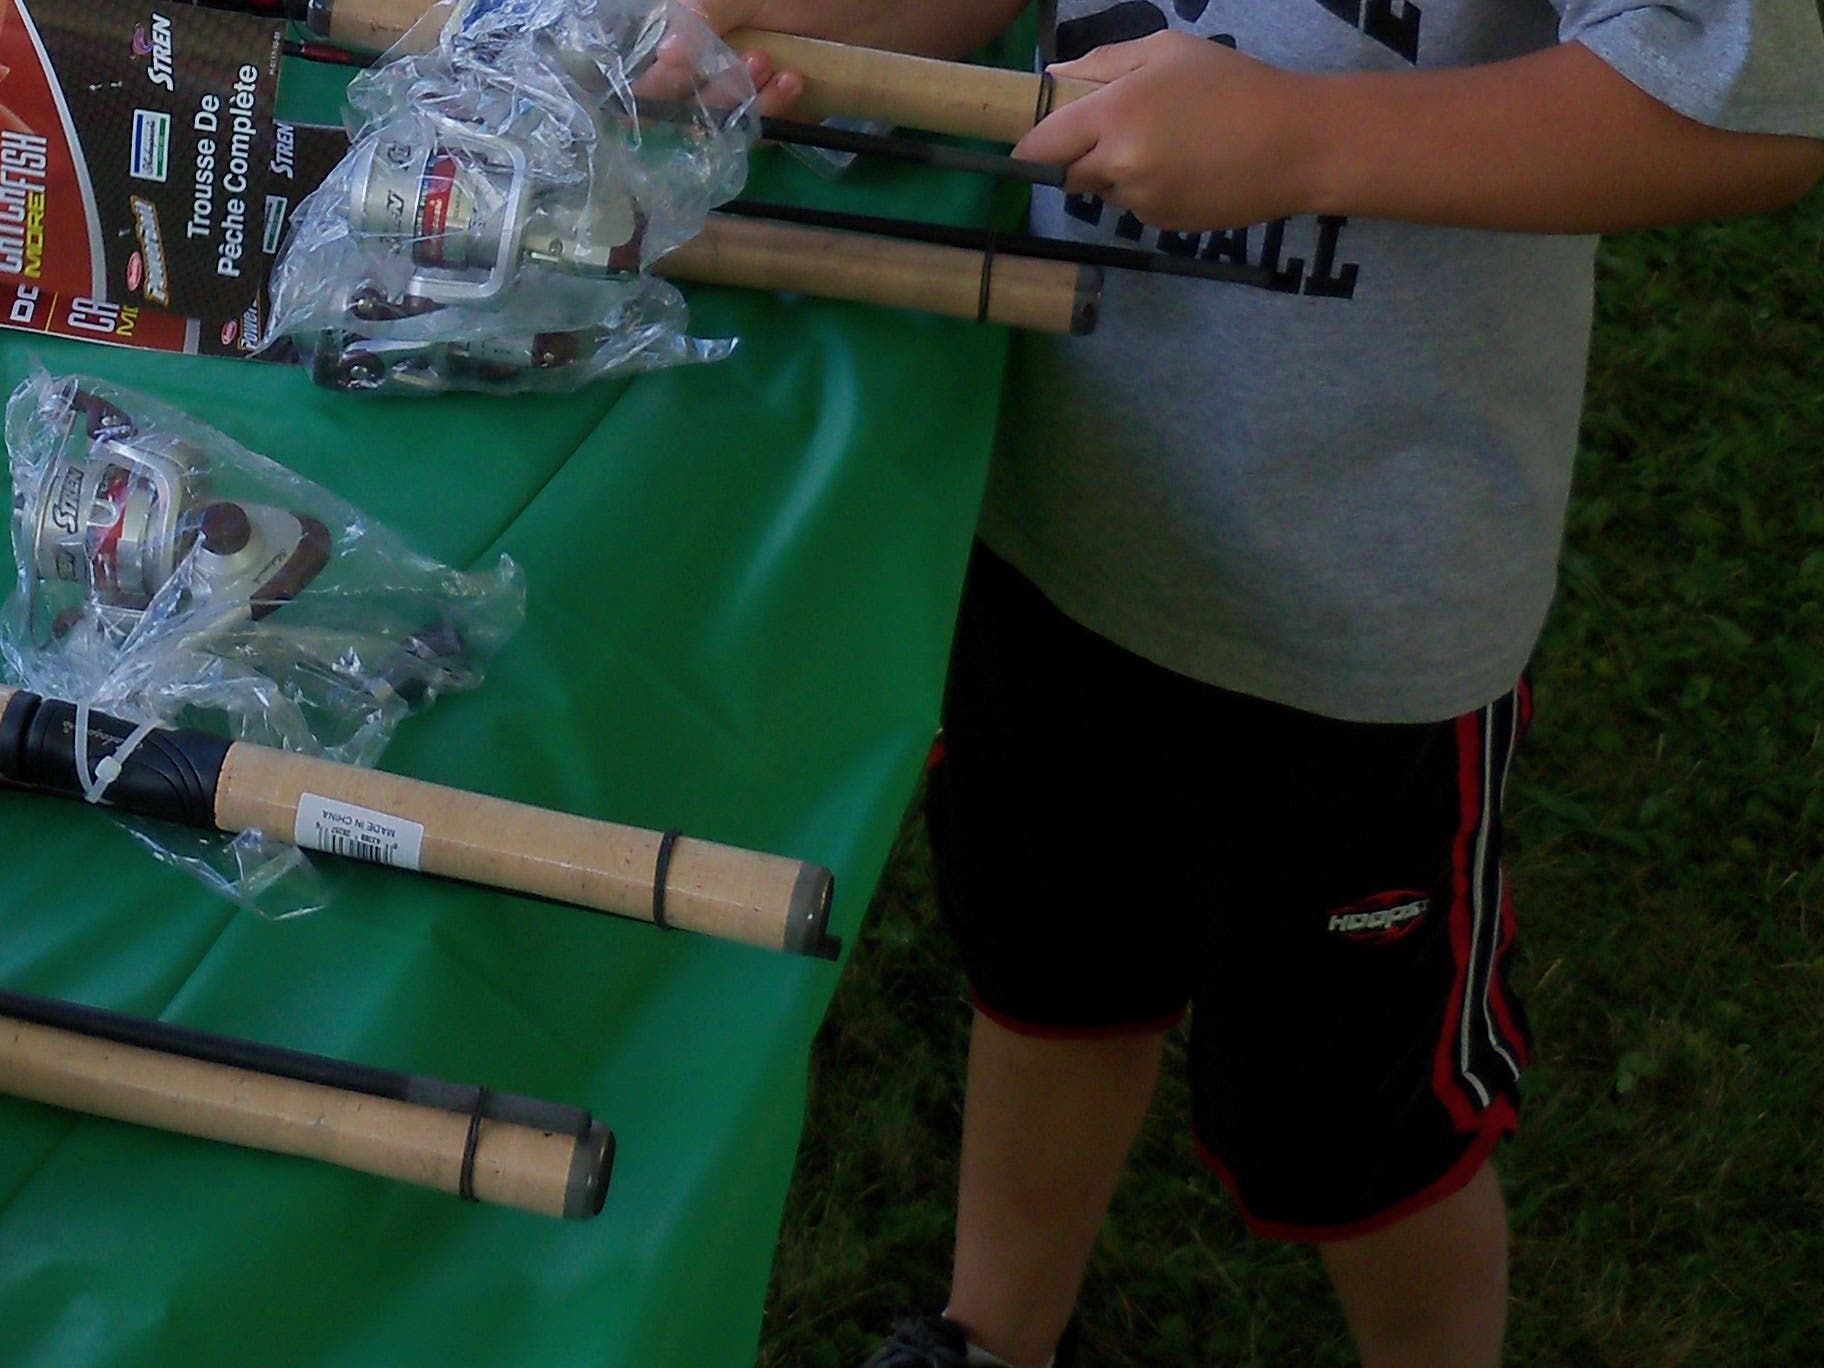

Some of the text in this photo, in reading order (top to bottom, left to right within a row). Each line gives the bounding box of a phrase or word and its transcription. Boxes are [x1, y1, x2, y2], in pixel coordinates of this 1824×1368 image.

[146, 12, 174, 93] STREN
[0, 130, 48, 193] FISH
[186, 92, 222, 240] Trousse De
[217, 62, 260, 278] Pêche Complète
[270, 121, 296, 180] STREN
[23, 190, 47, 279] MORE
[52, 465, 85, 535] STREN
[322, 809, 354, 826] CHINA
[367, 821, 397, 838] MADE
